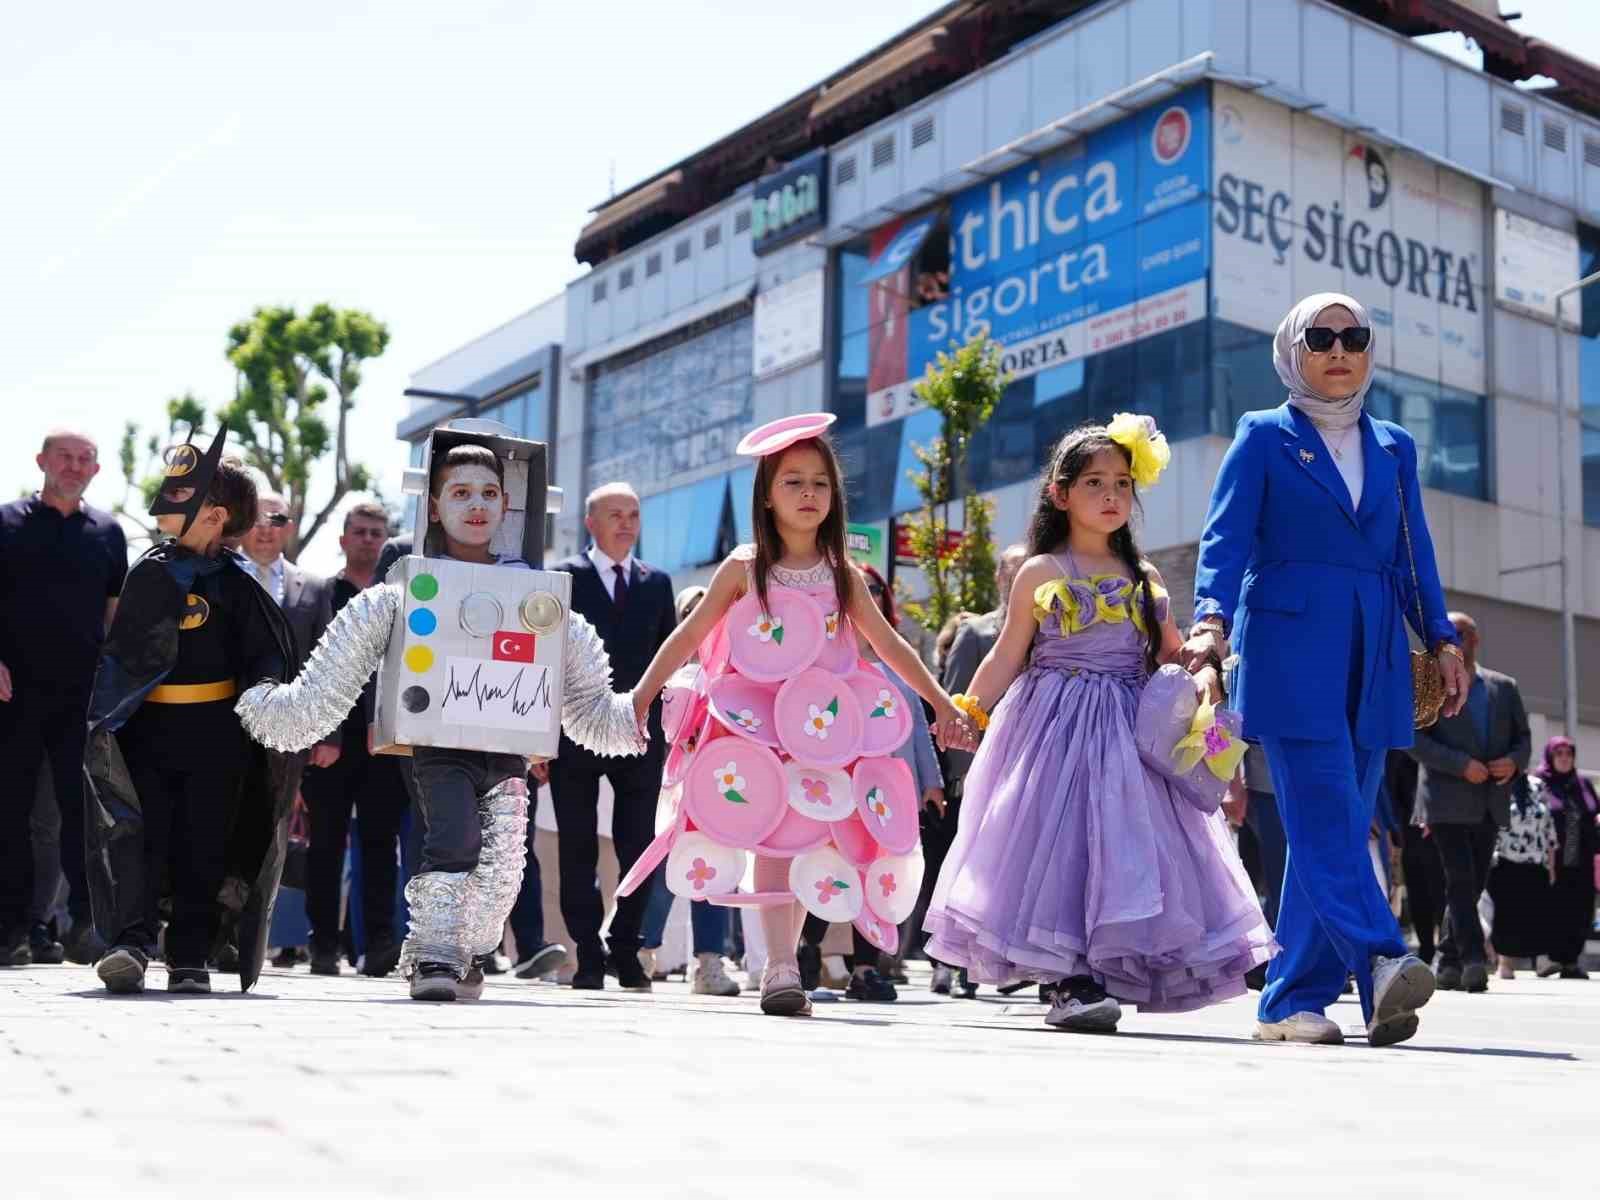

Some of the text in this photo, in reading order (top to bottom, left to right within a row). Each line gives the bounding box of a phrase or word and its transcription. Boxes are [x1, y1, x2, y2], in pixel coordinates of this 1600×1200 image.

[950, 160, 1122, 275] thica
[1214, 171, 1293, 266] SEÇ
[1303, 202, 1478, 314] SİGORTA
[927, 242, 1110, 343] sigorta
[1001, 337, 1068, 375] ORTA
